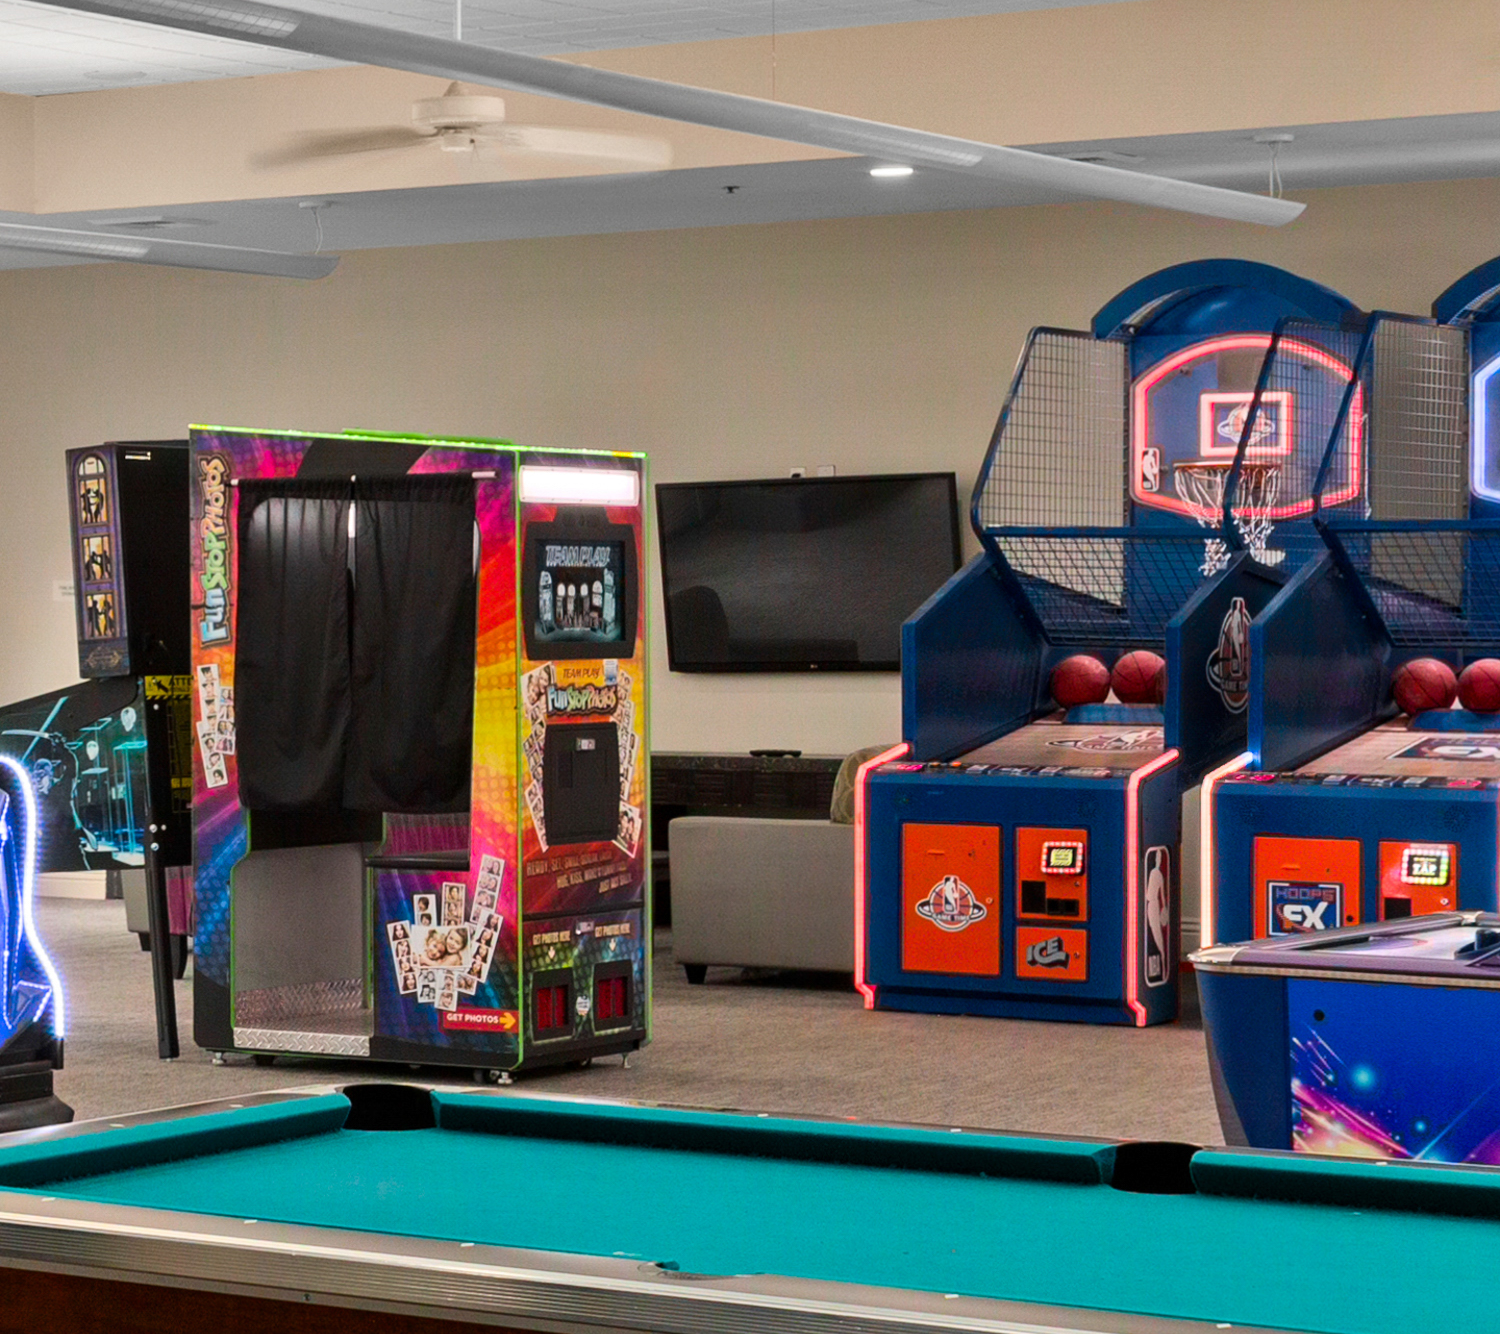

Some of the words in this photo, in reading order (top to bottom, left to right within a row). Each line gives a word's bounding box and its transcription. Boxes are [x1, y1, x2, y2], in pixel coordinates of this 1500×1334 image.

[545, 545, 579, 567] TEAM
[580, 546, 611, 567] PLAY
[563, 668, 582, 679] TEAM
[582, 668, 600, 679] PLAY
[1412, 863, 1438, 875] TAP
[1276, 887, 1336, 901] HOOPS
[1283, 902, 1328, 930] FX
[1026, 937, 1061, 965] ICE
[446, 1013, 463, 1021] GET
[464, 1014, 499, 1024] PHOTOS
